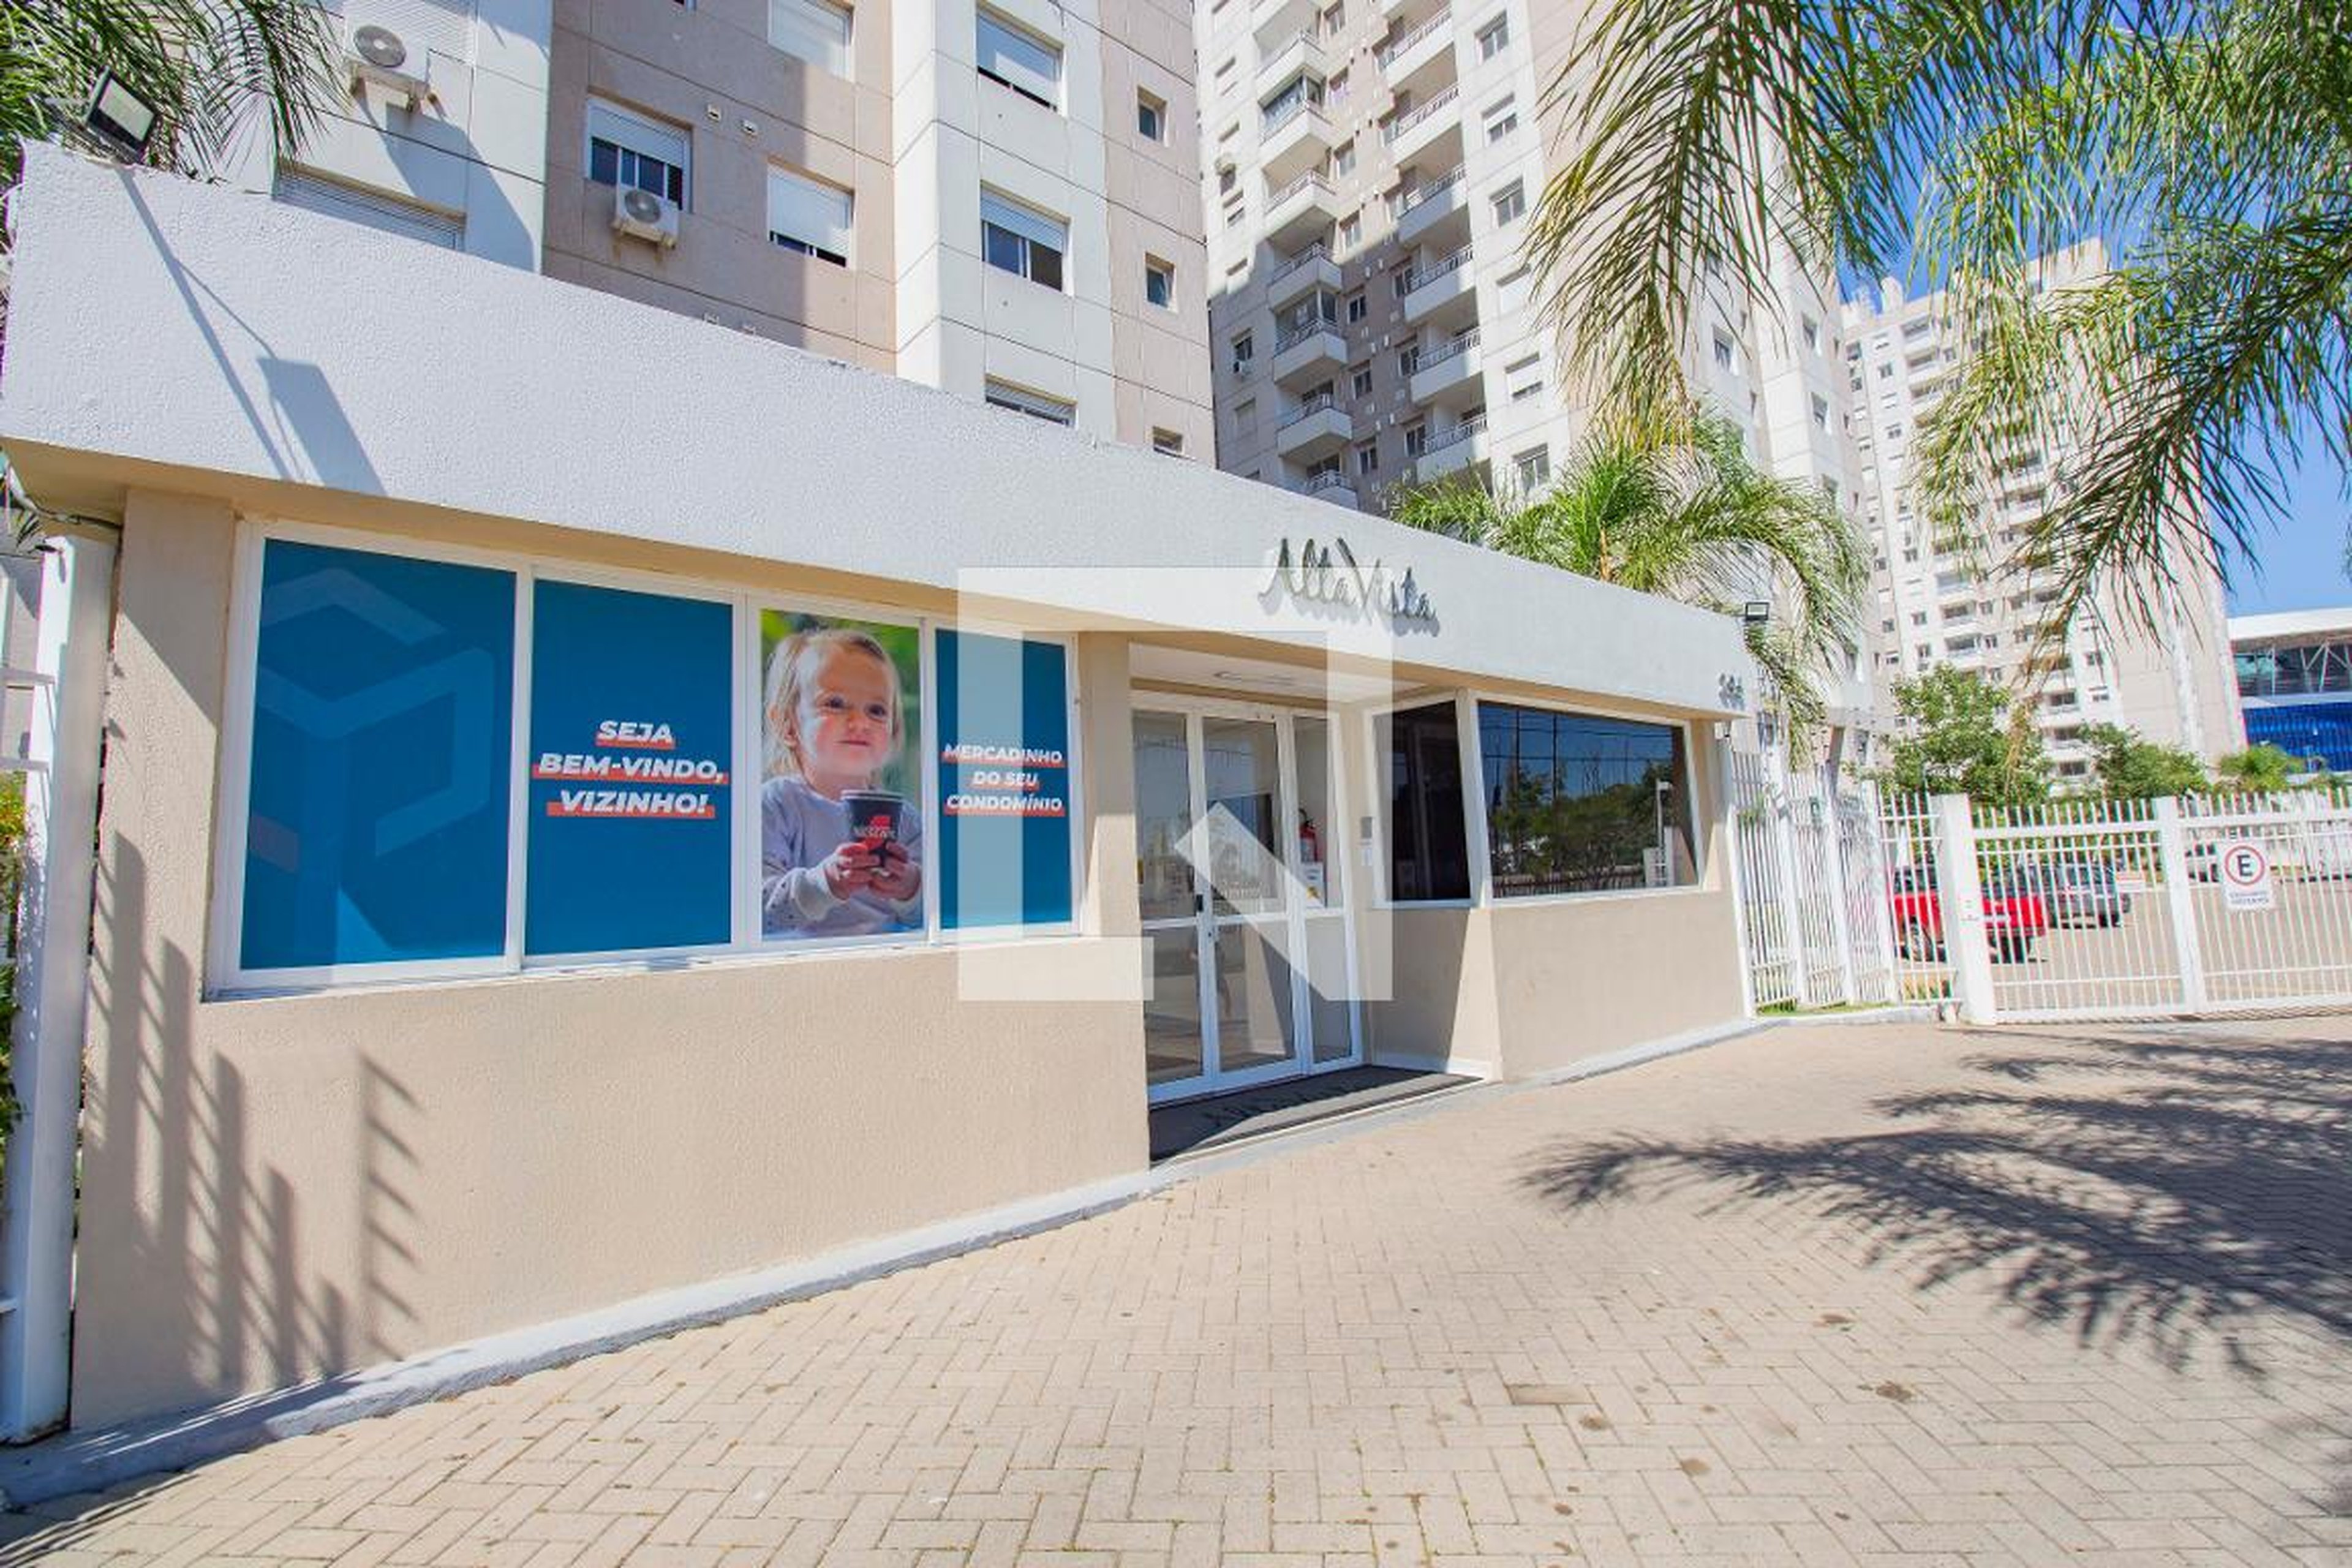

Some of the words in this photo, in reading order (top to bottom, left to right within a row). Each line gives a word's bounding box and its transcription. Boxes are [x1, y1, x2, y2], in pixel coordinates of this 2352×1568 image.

[598, 720, 674, 743] SEJA
[944, 743, 1063, 764] MERCADINHO
[538, 753, 724, 783] BEM-VINDO,
[972, 771, 1001, 785] DO
[1004, 772, 1039, 786] SEU
[560, 790, 709, 814] VIZINHO!
[946, 793, 1063, 812] CONDOMÍNIO
[2237, 854, 2253, 877] E
